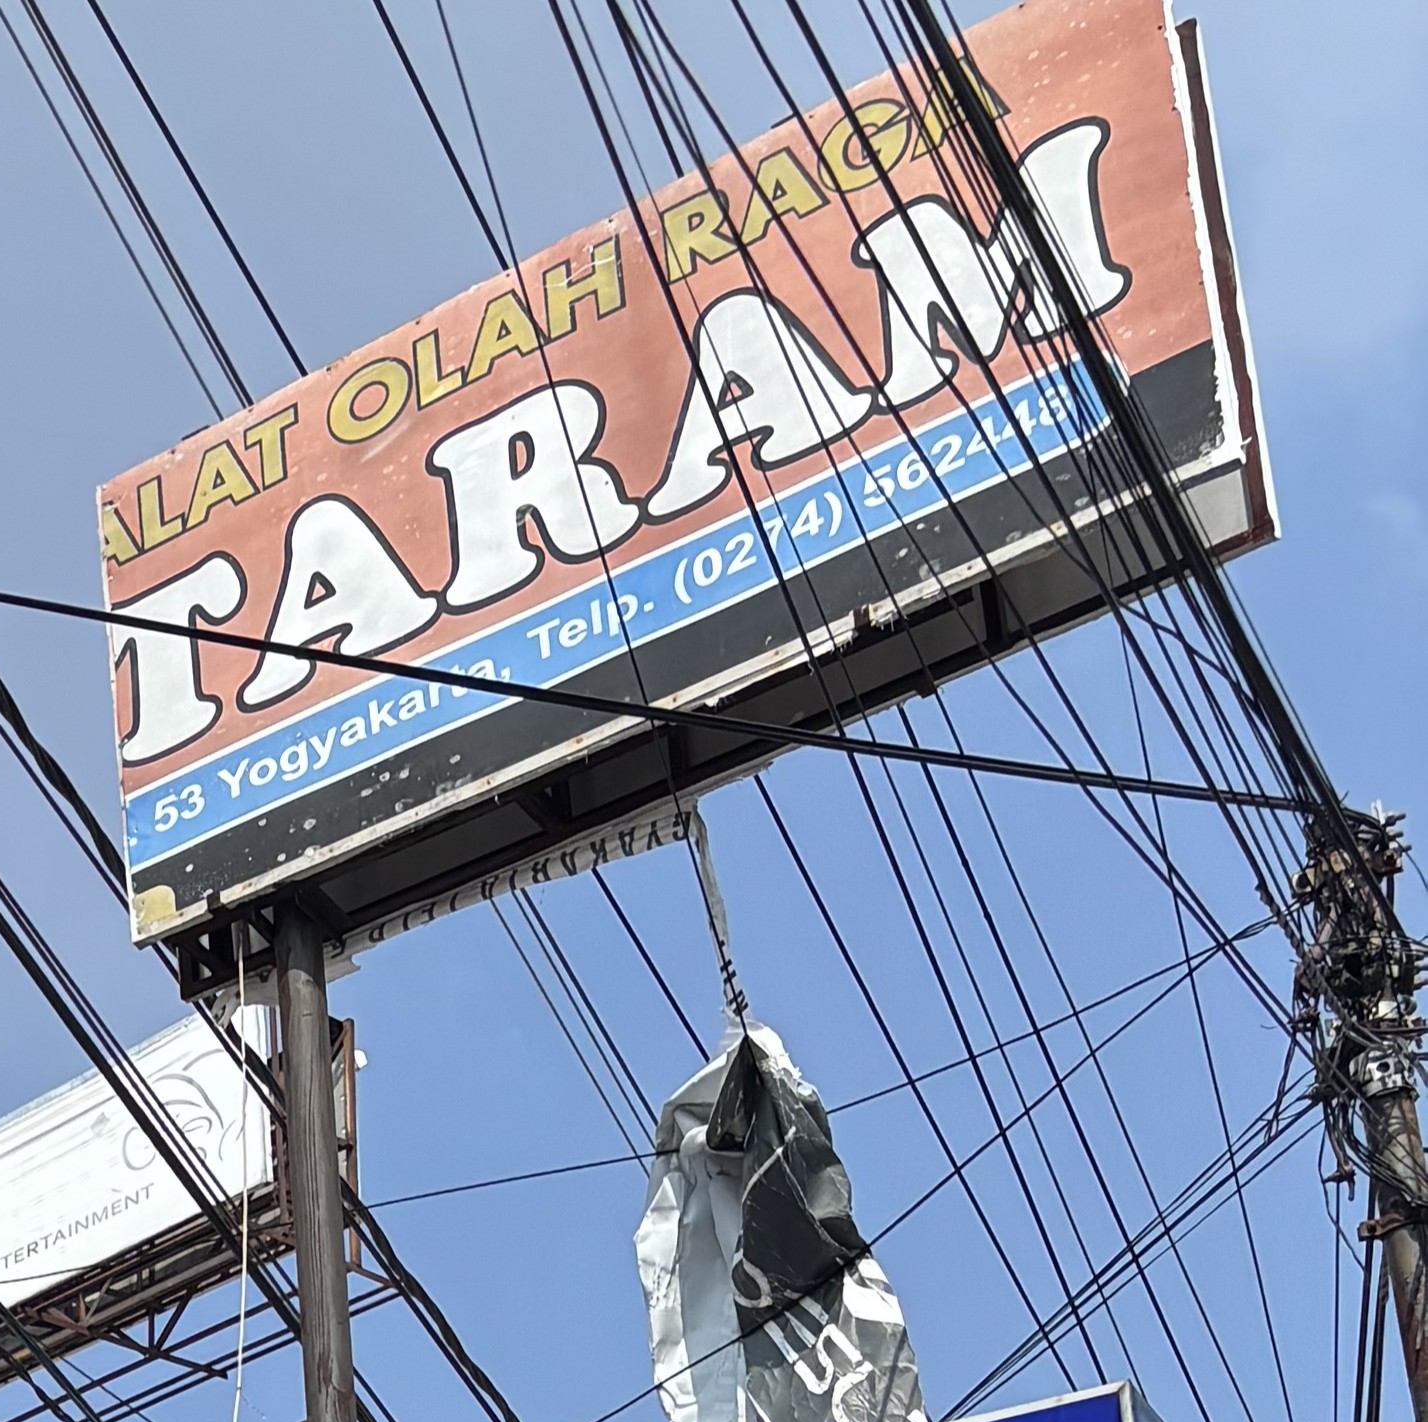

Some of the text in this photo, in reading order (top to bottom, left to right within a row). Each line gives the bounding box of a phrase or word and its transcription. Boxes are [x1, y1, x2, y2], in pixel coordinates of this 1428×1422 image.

[328, 235, 625, 443] OLAH
[662, 56, 1011, 284] RAGA
[153, 789, 205, 833] 53
[527, 598, 653, 659] Telp.
